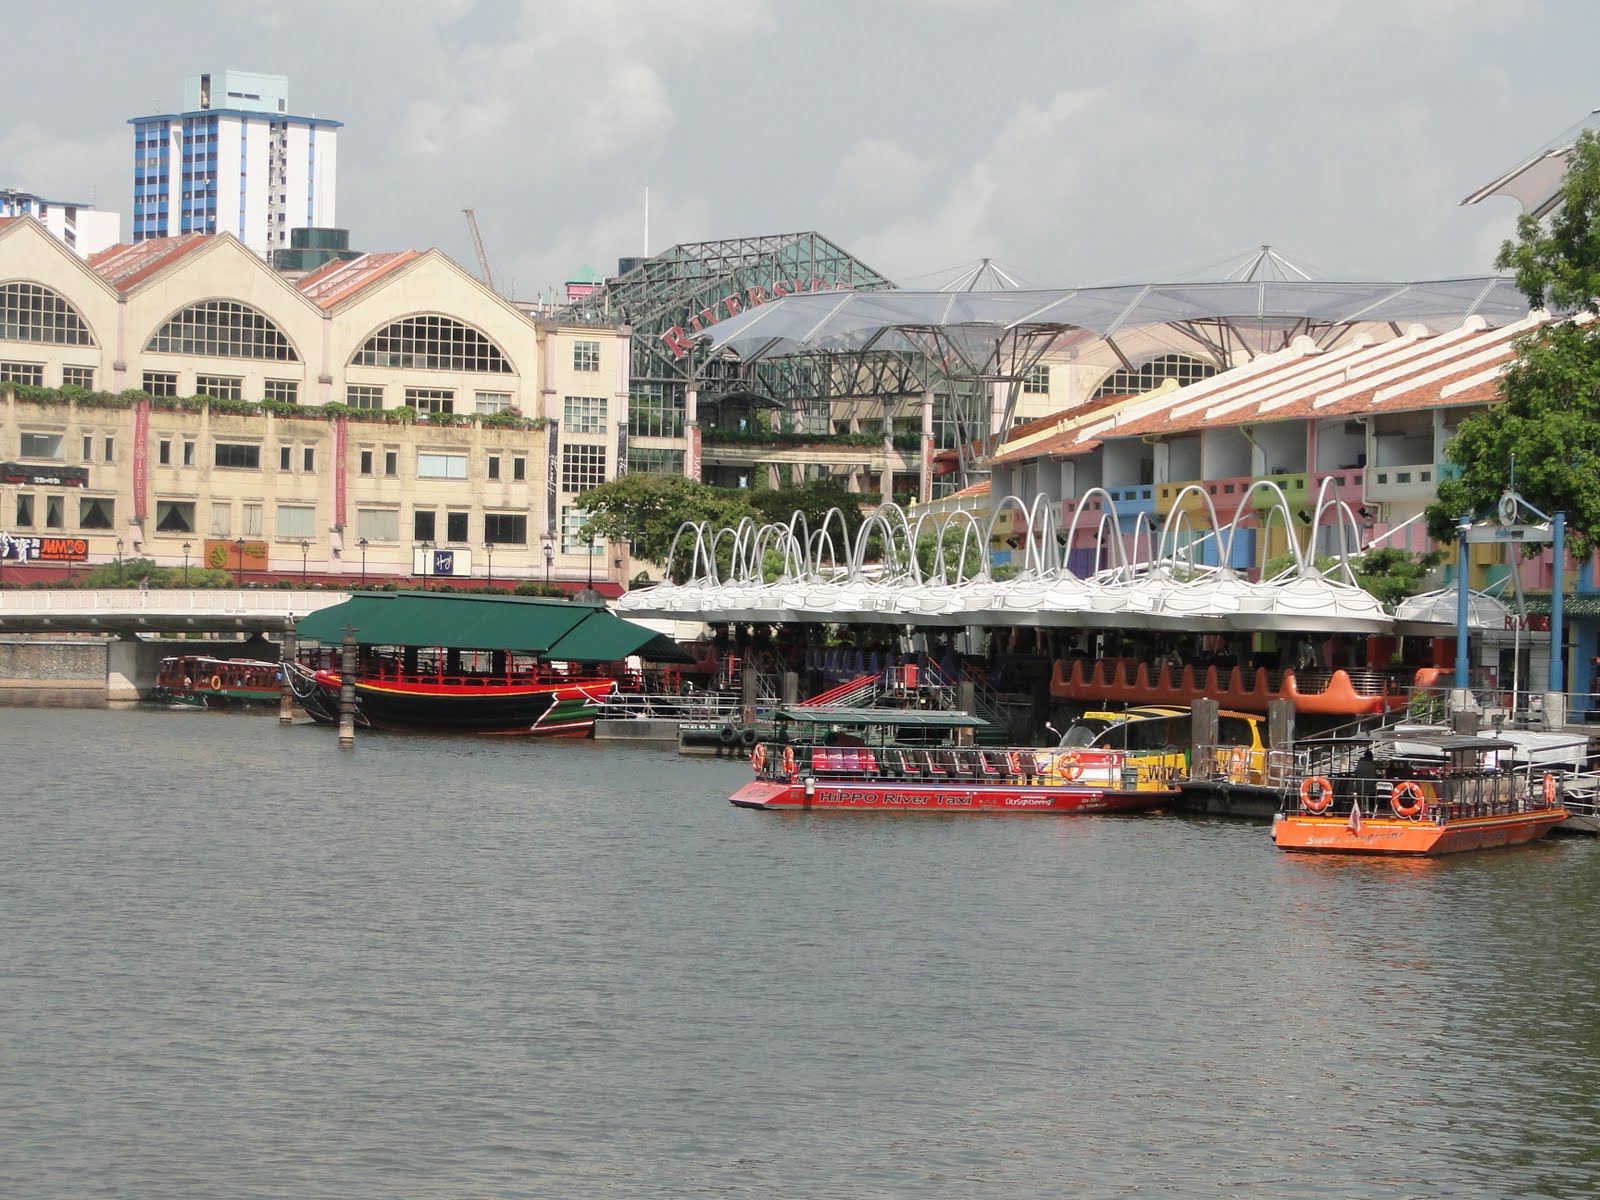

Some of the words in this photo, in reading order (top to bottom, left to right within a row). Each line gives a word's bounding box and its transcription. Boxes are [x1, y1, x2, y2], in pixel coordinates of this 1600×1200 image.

[41, 539, 86, 555] JUMBO
[819, 791, 879, 804] HiPPO
[882, 792, 931, 805] River
[935, 793, 973, 806] Taxi
